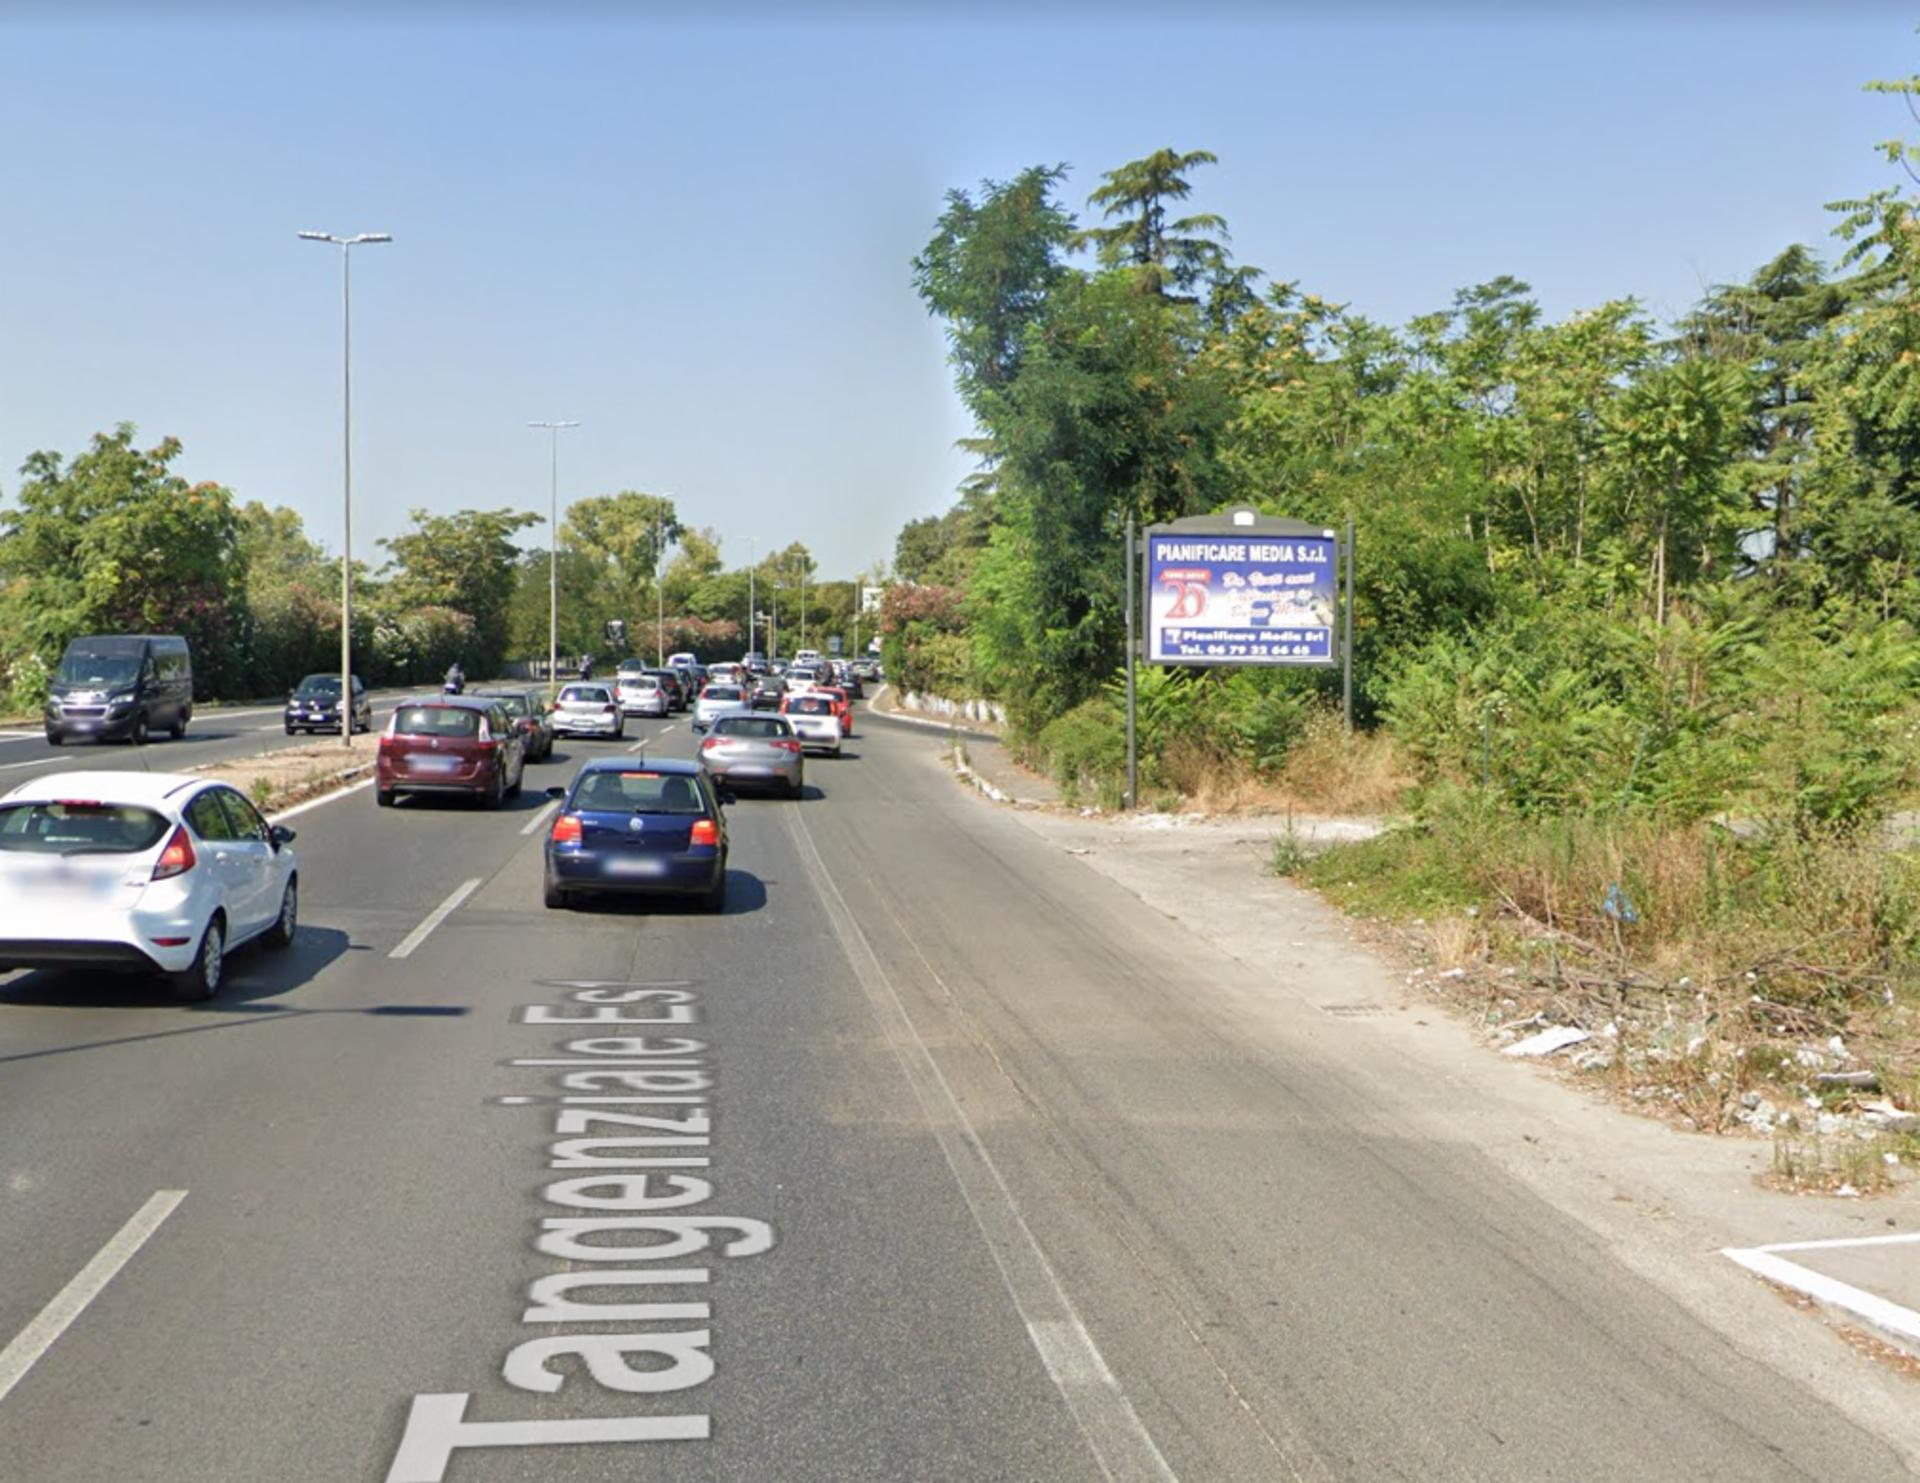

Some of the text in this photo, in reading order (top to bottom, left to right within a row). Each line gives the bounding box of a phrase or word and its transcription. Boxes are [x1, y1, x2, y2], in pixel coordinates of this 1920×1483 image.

[1157, 543, 1327, 563] PIANIFICARE MEDIA S.r.l.
[1164, 580, 1207, 618] 20
[1259, 630, 1302, 642] Media
